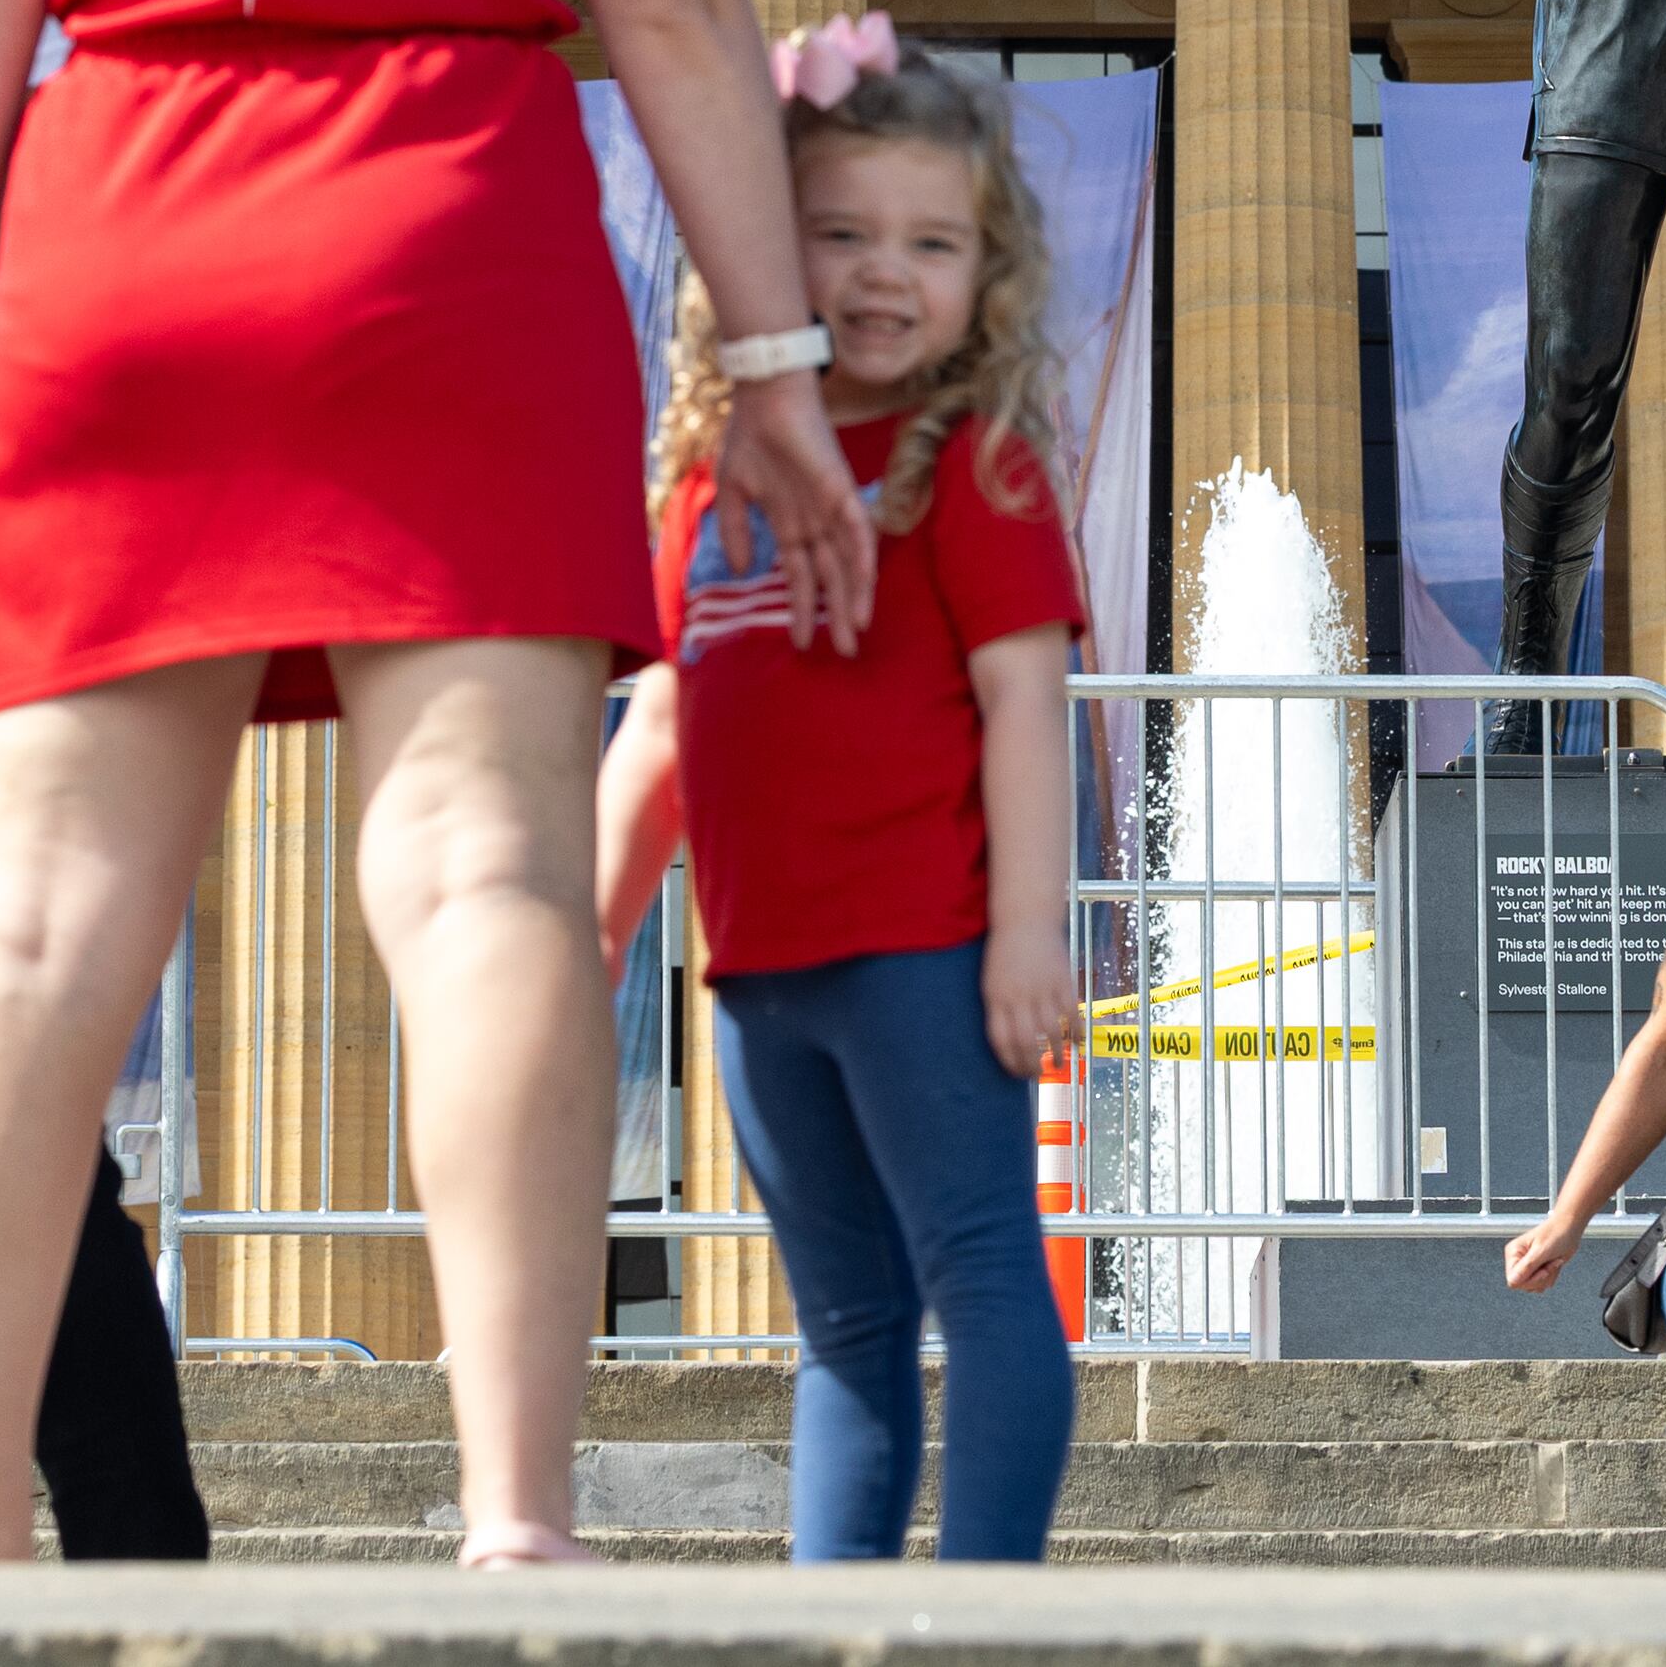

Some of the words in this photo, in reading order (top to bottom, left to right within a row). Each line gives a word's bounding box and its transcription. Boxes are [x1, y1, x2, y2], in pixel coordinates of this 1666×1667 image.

[1517, 885, 1538, 897] not
[1569, 885, 1598, 896] hard
[1625, 885, 1646, 896] hit.
[1648, 885, 1666, 896] It's
[1496, 901, 1520, 913] you
[1522, 901, 1545, 910] can
[1576, 898, 1593, 910] hit
[1595, 900, 1612, 910] an
[1621, 898, 1652, 912] keep
[1513, 912, 1547, 923] that's
[1579, 911, 1628, 925] winnig
[1630, 911, 1641, 923] is
[1497, 937, 1523, 949] This
[1525, 938, 1565, 949] stae
[1567, 937, 1578, 949] is
[1646, 938, 1660, 949] to
[1497, 951, 1573, 963] Philadelhia
[1575, 951, 1599, 962] and
[1601, 951, 1622, 962] th
[1624, 951, 1666, 962] brothe
[1498, 983, 1549, 998] Sylveste
[1557, 983, 1607, 995] Stallone
